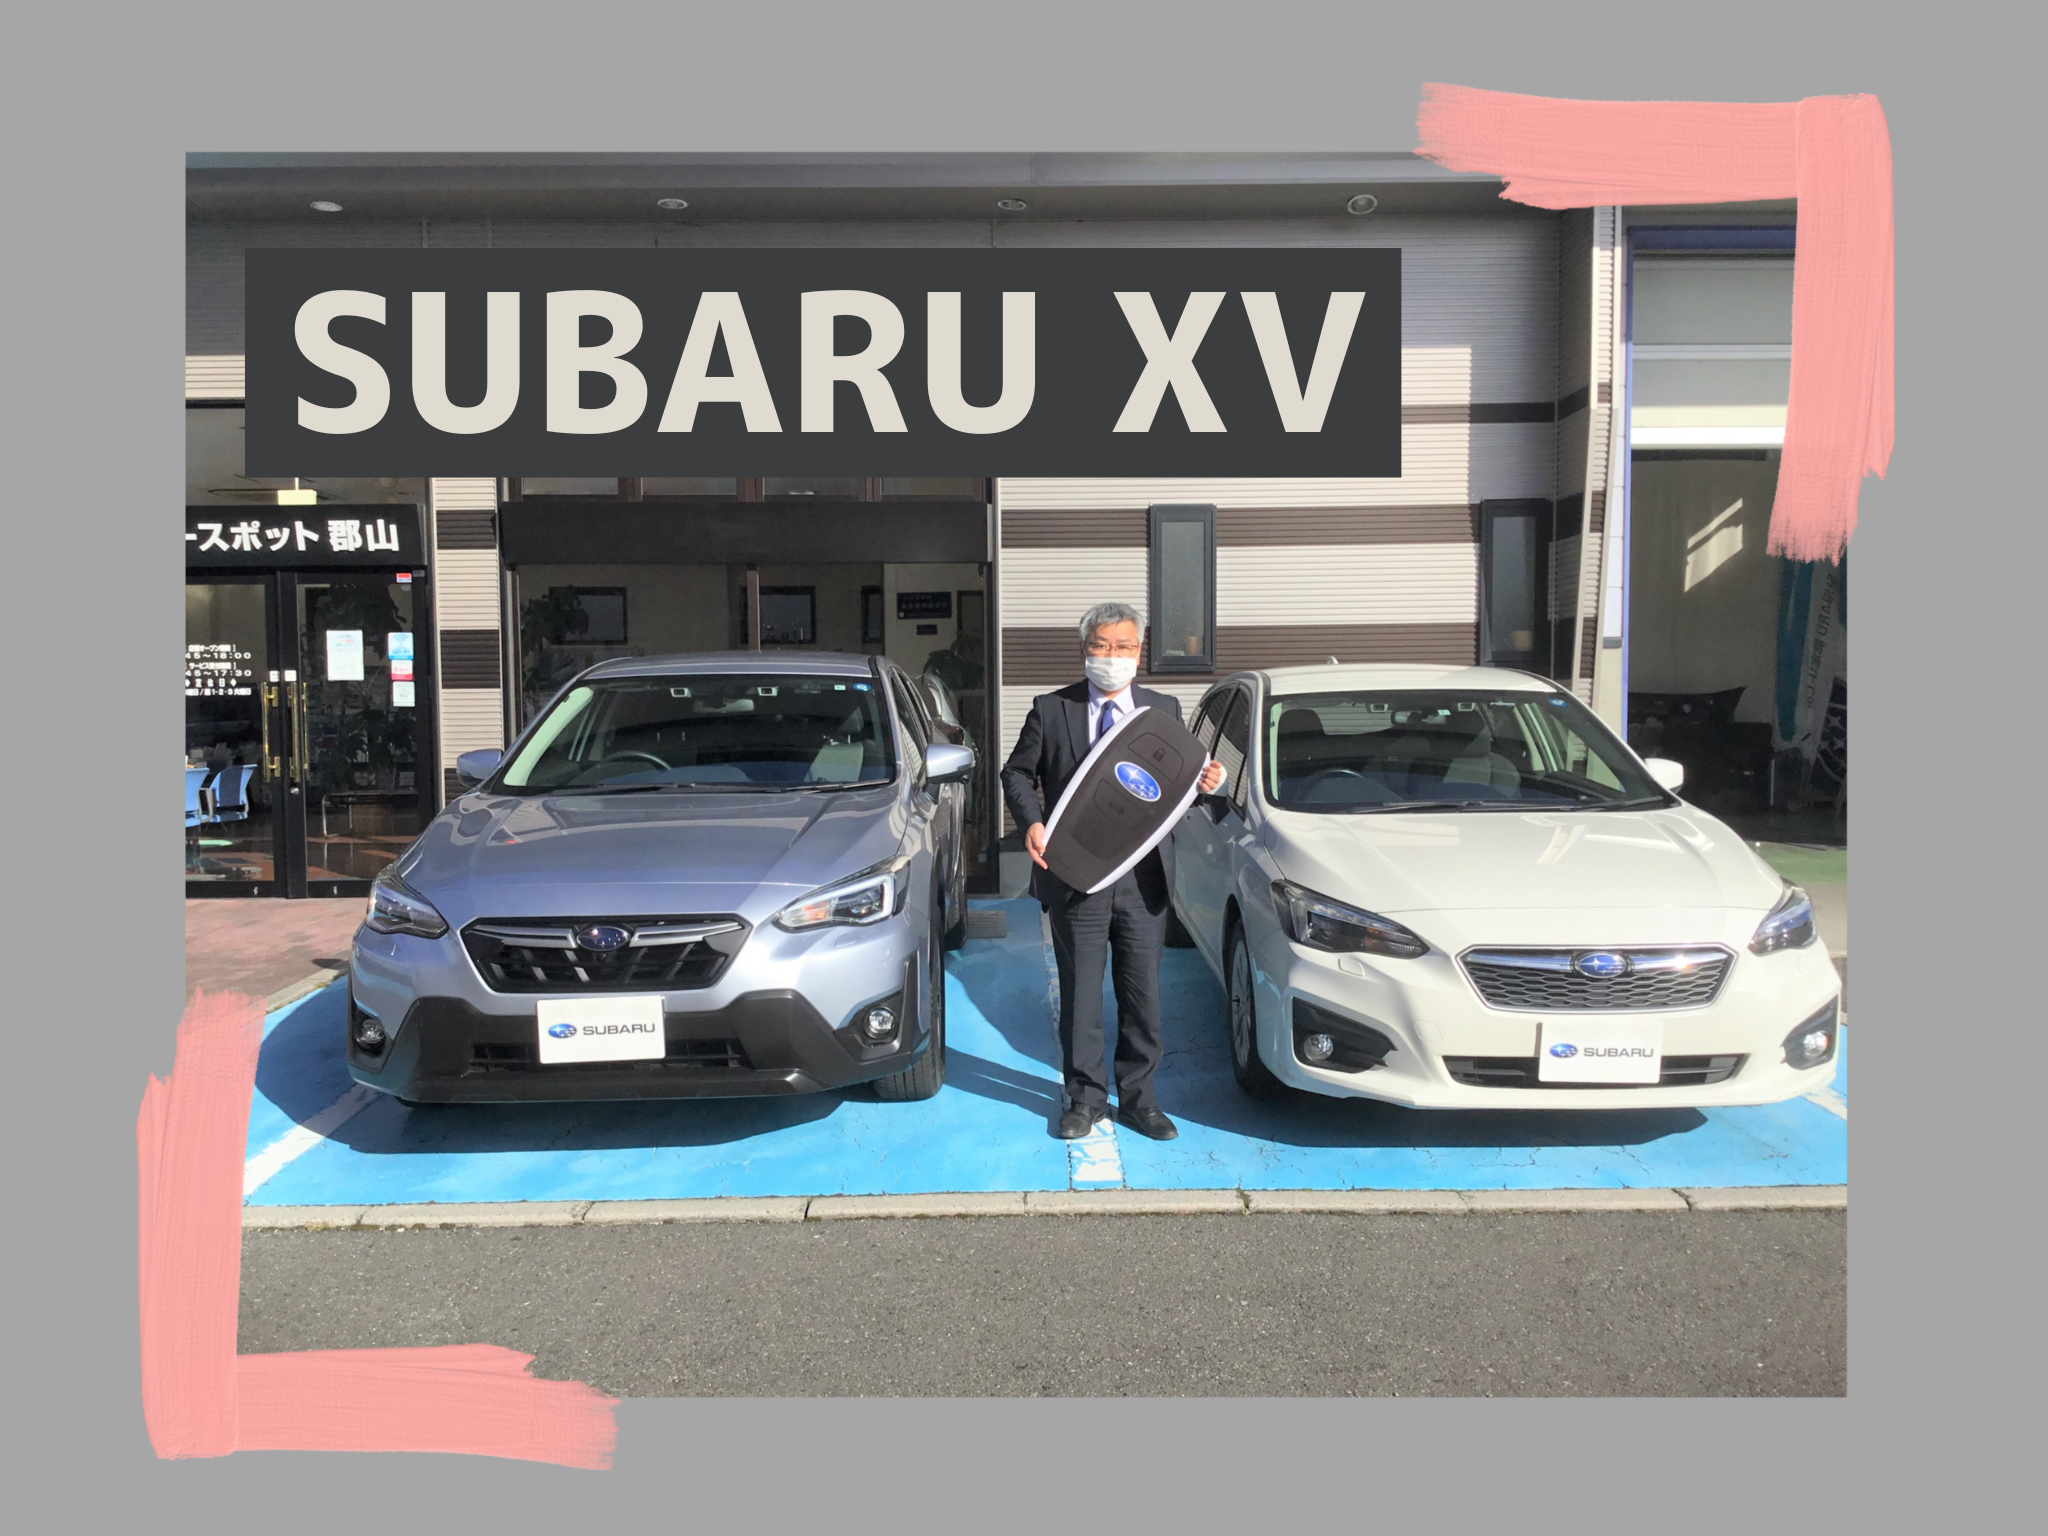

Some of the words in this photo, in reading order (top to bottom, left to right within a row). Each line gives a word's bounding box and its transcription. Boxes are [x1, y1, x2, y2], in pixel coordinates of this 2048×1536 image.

[327, 519, 400, 551] 郡山
[582, 1023, 656, 1036] SUBARU
[1583, 1047, 1654, 1058] SUBARU
